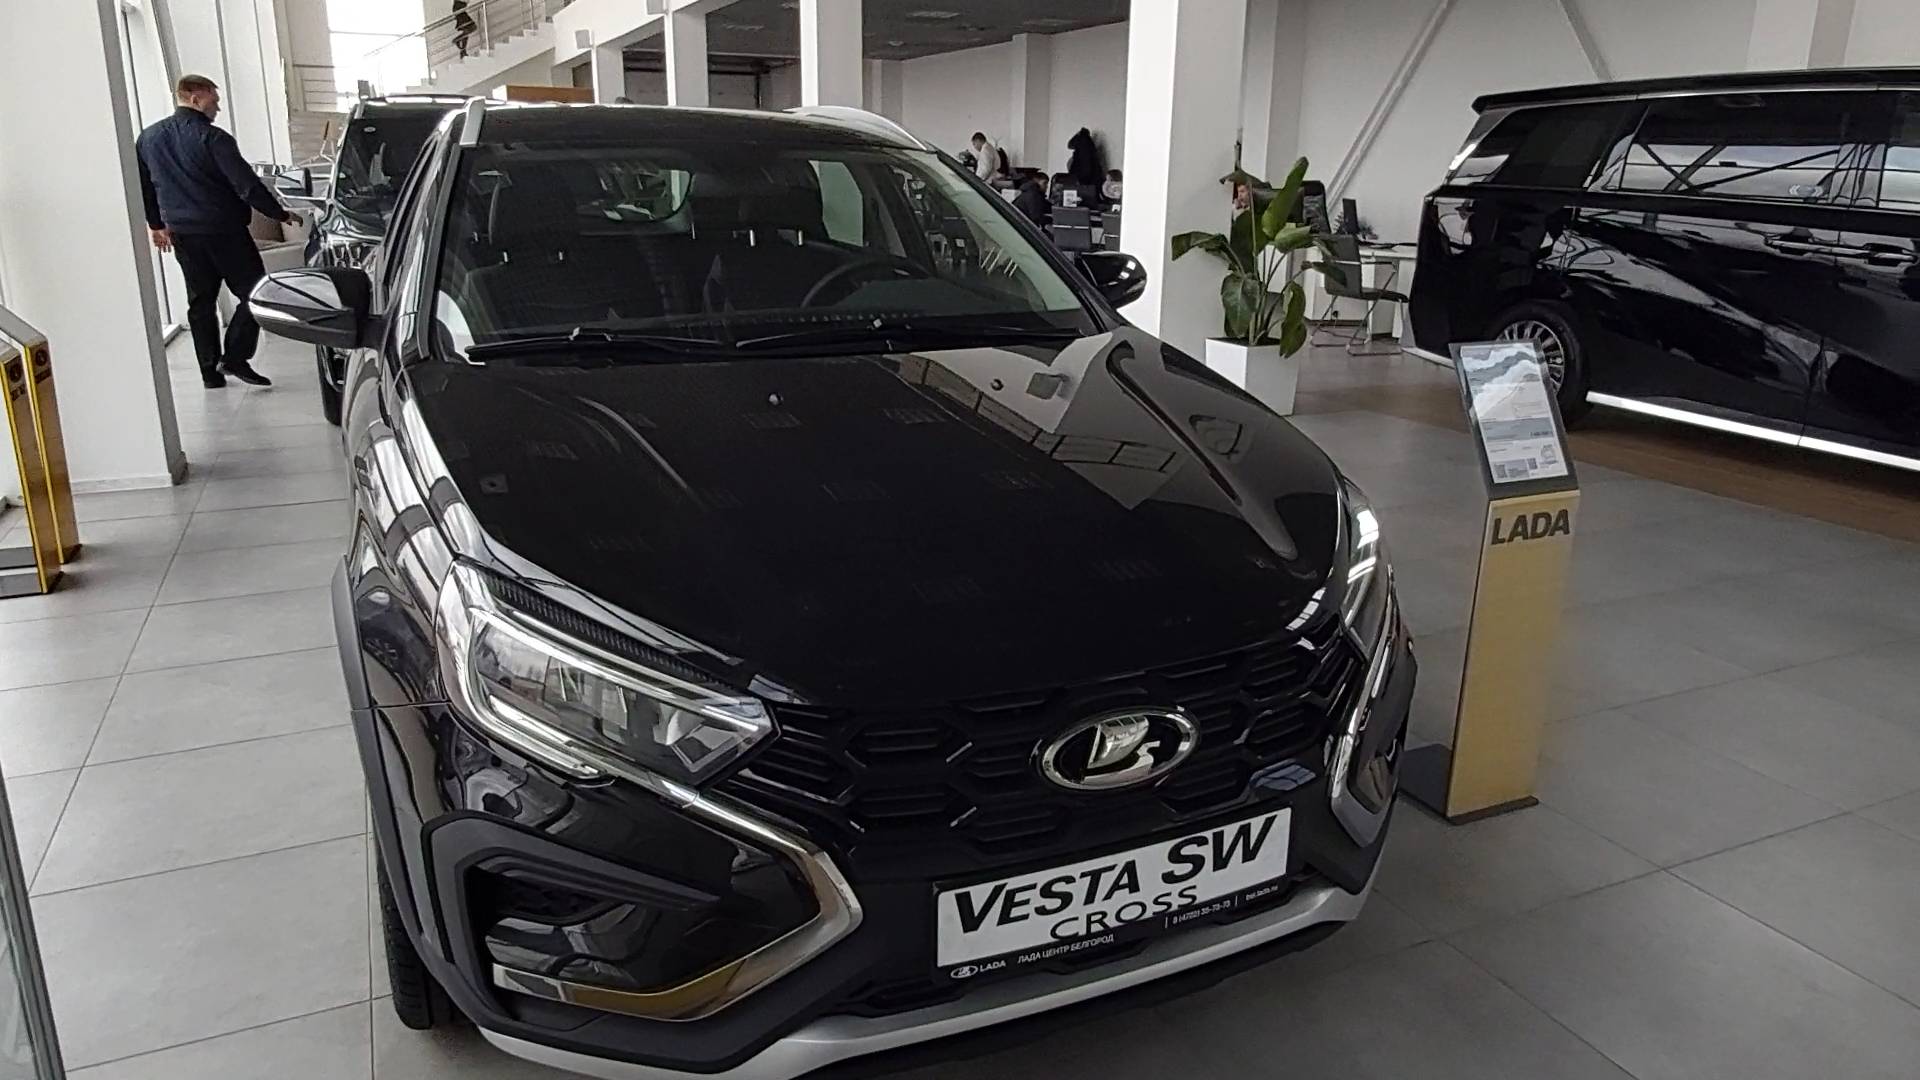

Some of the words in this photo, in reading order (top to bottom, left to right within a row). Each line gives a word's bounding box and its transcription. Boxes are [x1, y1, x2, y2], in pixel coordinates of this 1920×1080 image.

[1491, 509, 1570, 545] LADA
[955, 859, 1140, 934] VESTA
[1161, 814, 1278, 885] SW
[1050, 885, 1197, 940] CROSS
[979, 960, 1006, 972] LADA
[1017, 951, 1041, 964] ЛАДА
[1042, 945, 1070, 958] ЦЕНТР
[1070, 934, 1114, 951] БЕЛГОРОД
